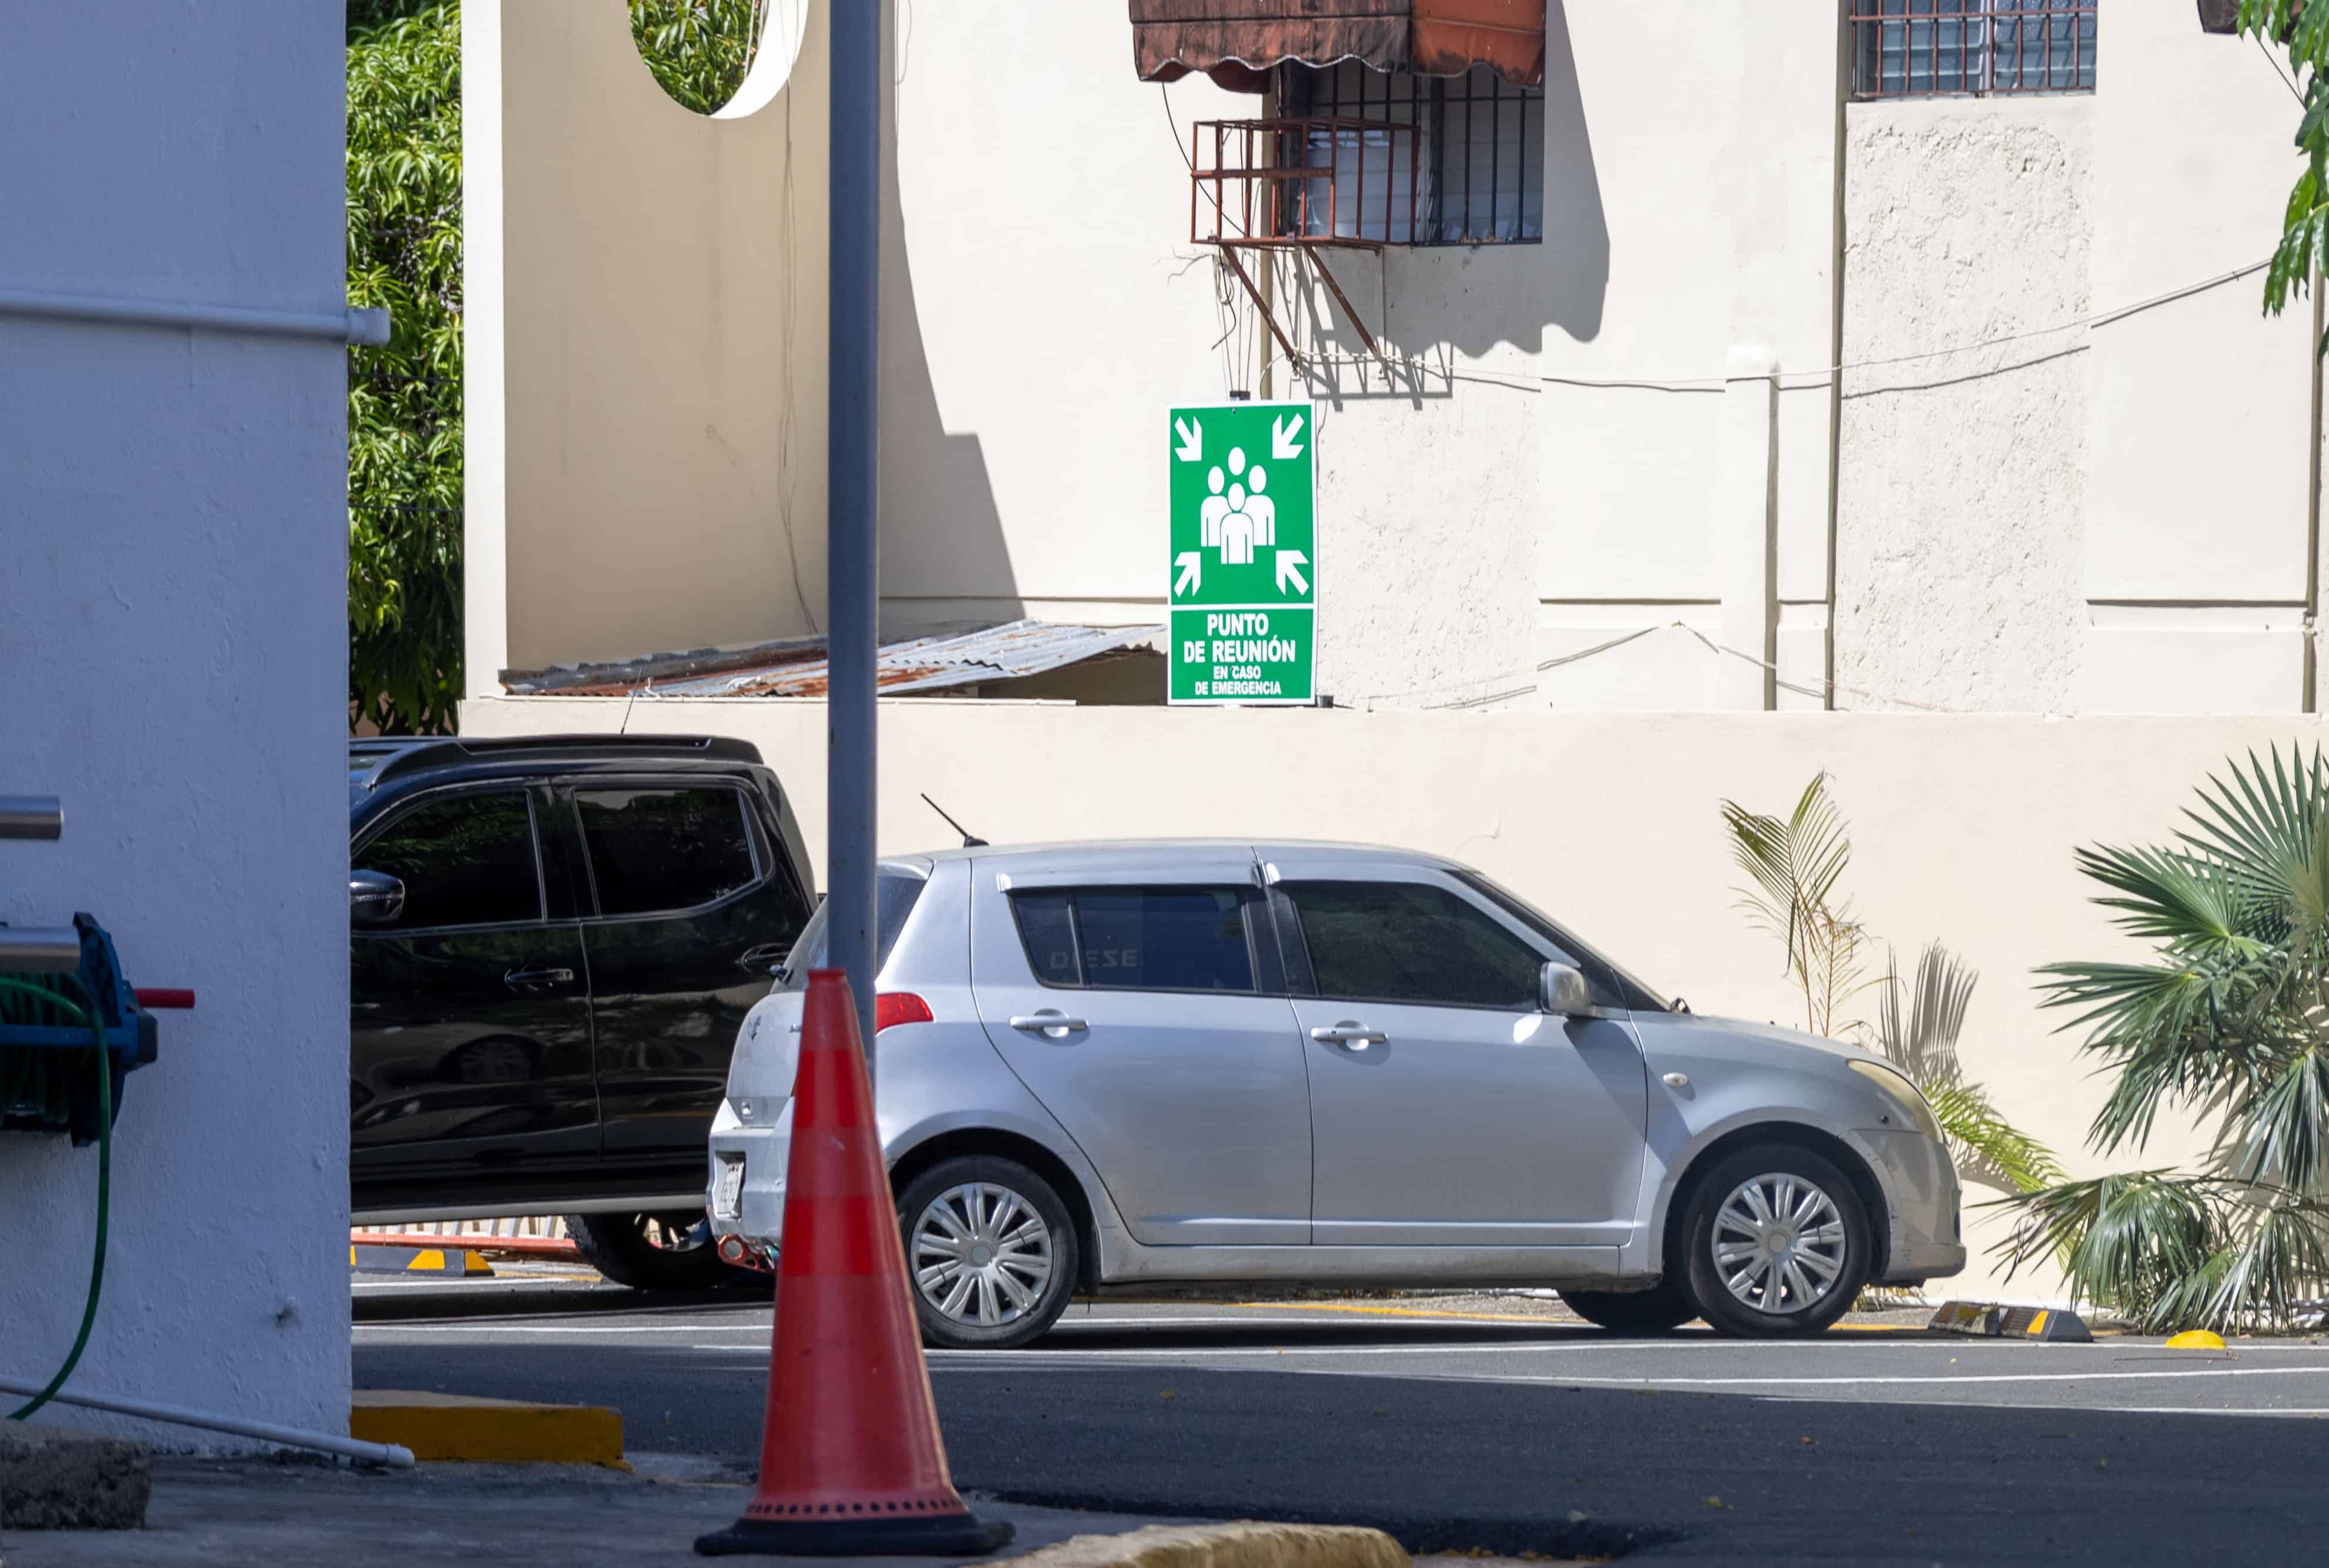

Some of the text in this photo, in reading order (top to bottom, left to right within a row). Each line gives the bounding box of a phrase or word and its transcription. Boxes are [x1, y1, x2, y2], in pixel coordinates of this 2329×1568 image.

[1207, 613, 1269, 636] PUNTO
[1184, 635, 1296, 663] DE REUNIÓN
[1213, 665, 1262, 680] EN CASO
[1195, 680, 1282, 696] DE EMERGENCIA
